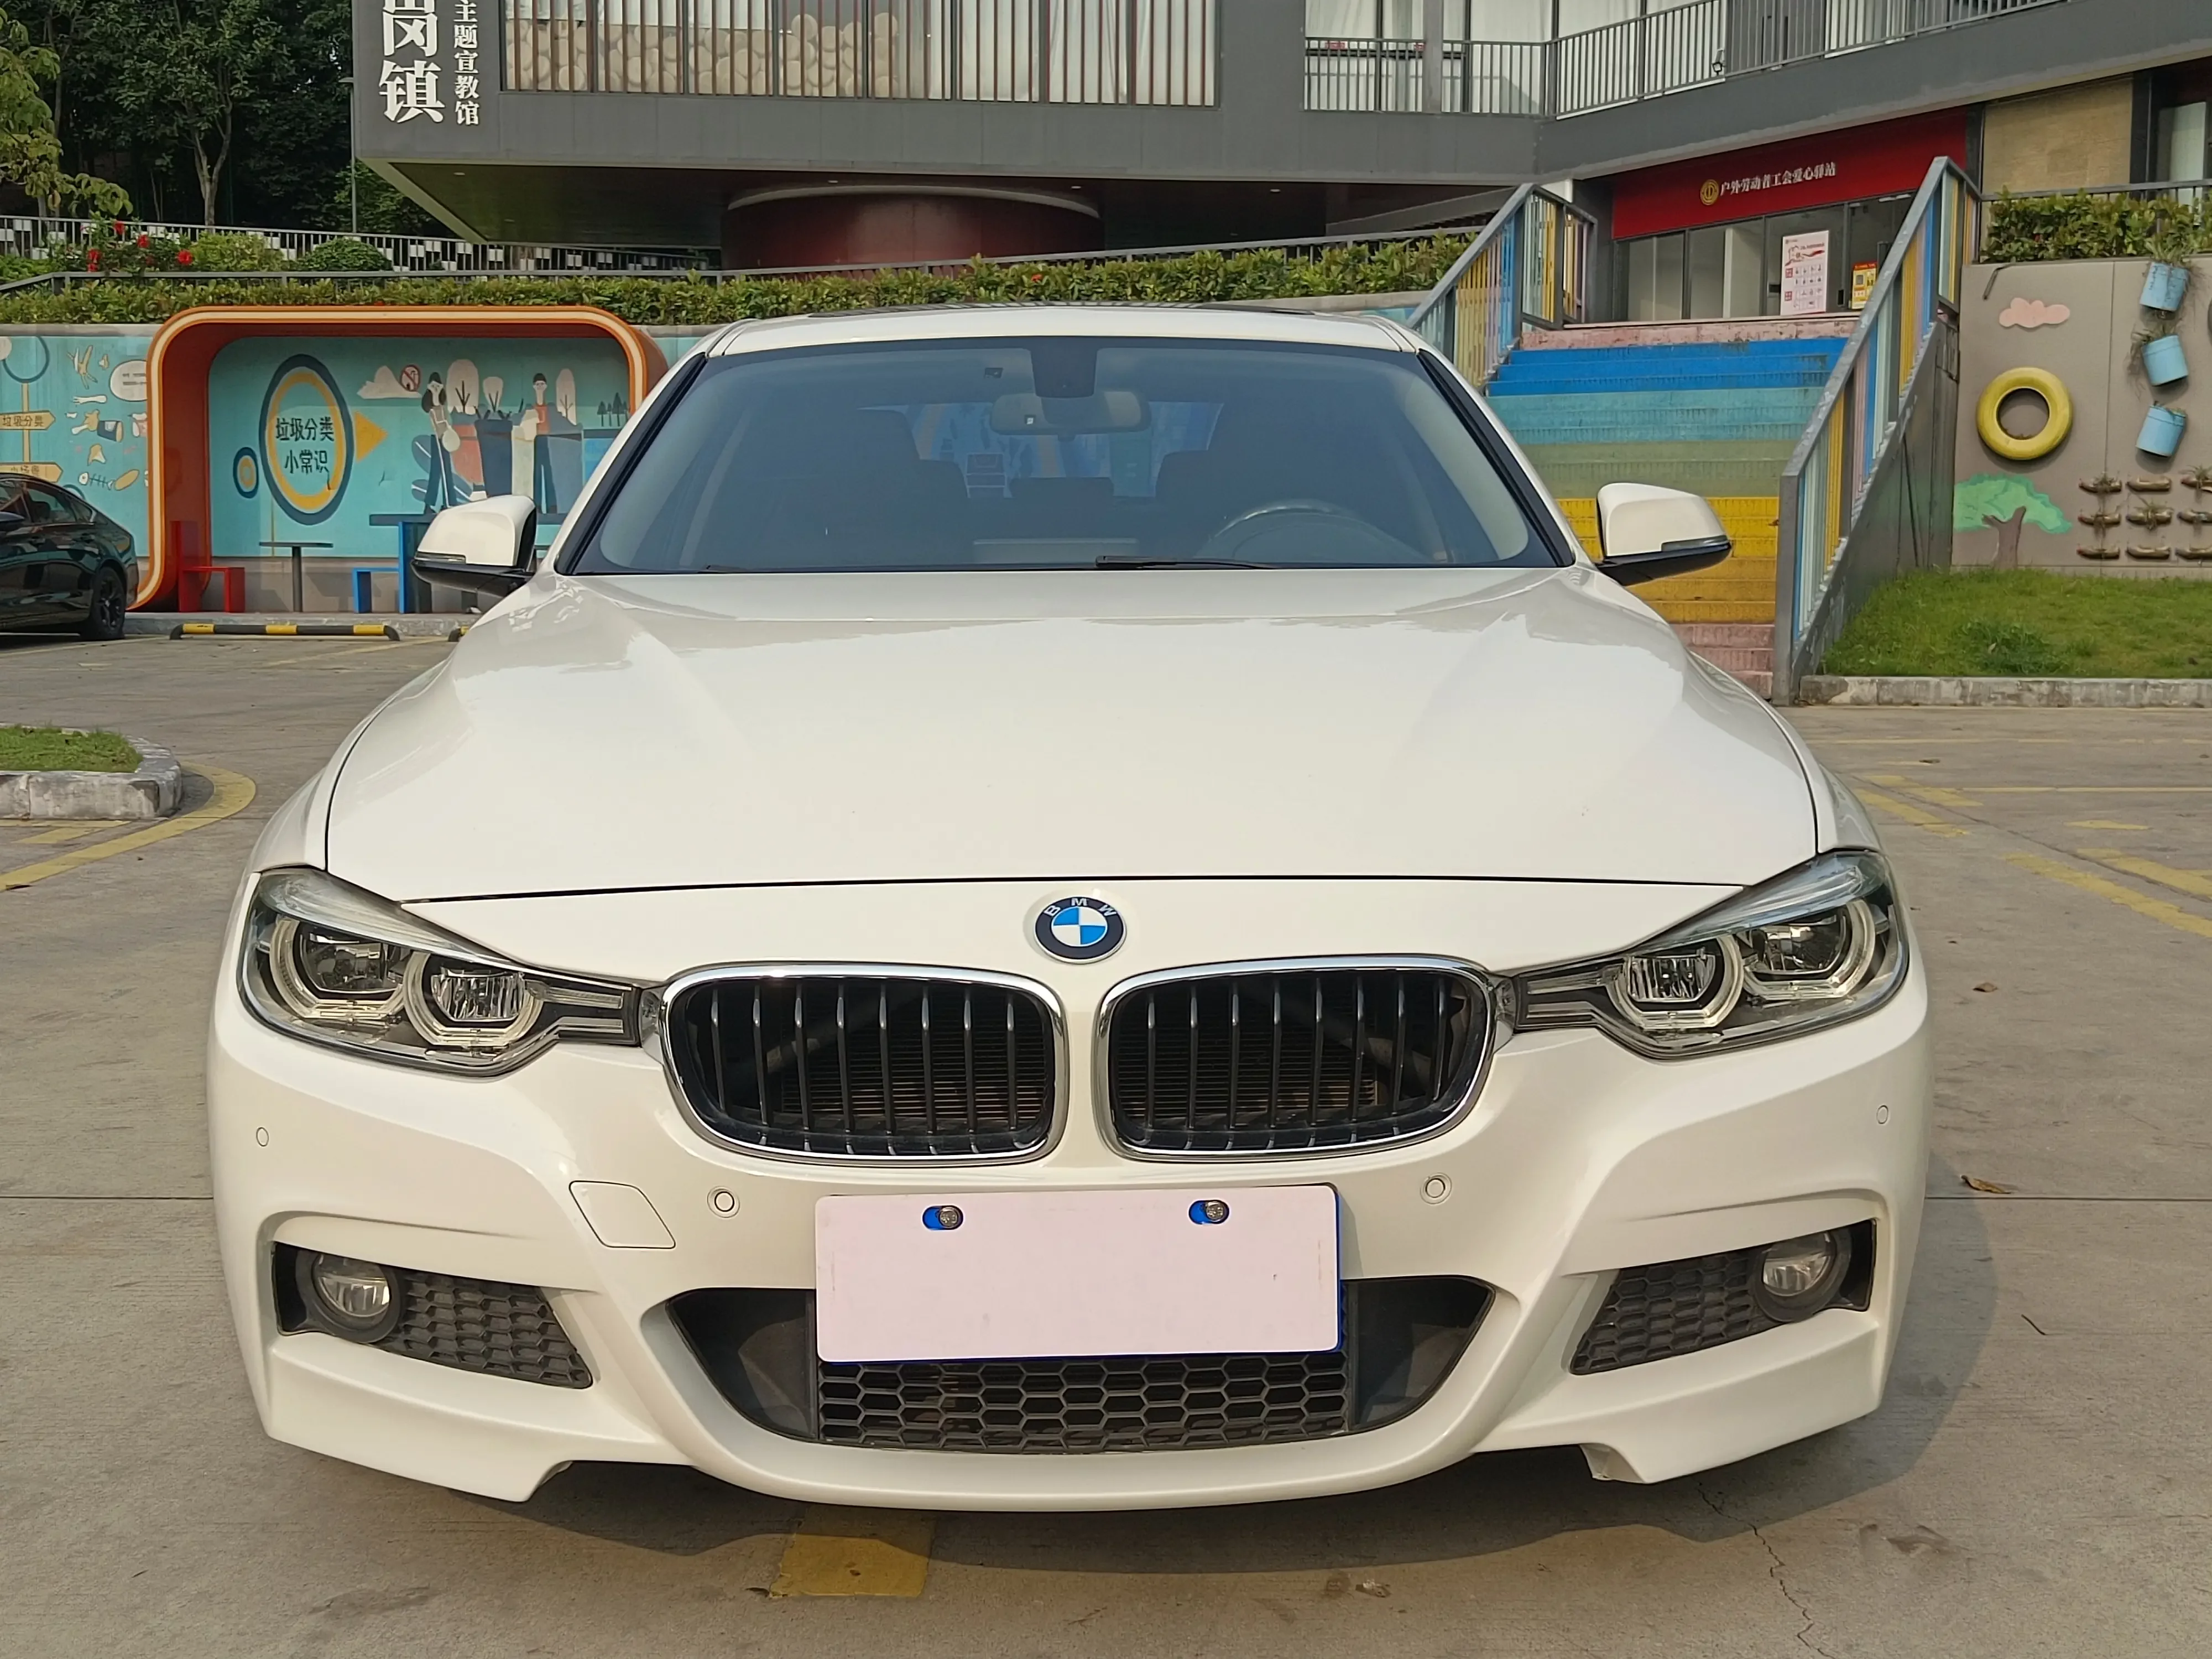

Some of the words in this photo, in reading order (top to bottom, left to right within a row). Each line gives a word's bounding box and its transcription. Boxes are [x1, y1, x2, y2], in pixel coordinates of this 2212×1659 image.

[378, 0, 445, 123] 岗镇
[453, 0, 479, 125] 主题宣教馆
[276, 416, 334, 441] 垃圾分类
[284, 449, 329, 474] 小常识
[1044, 898, 1117, 916] BMW
